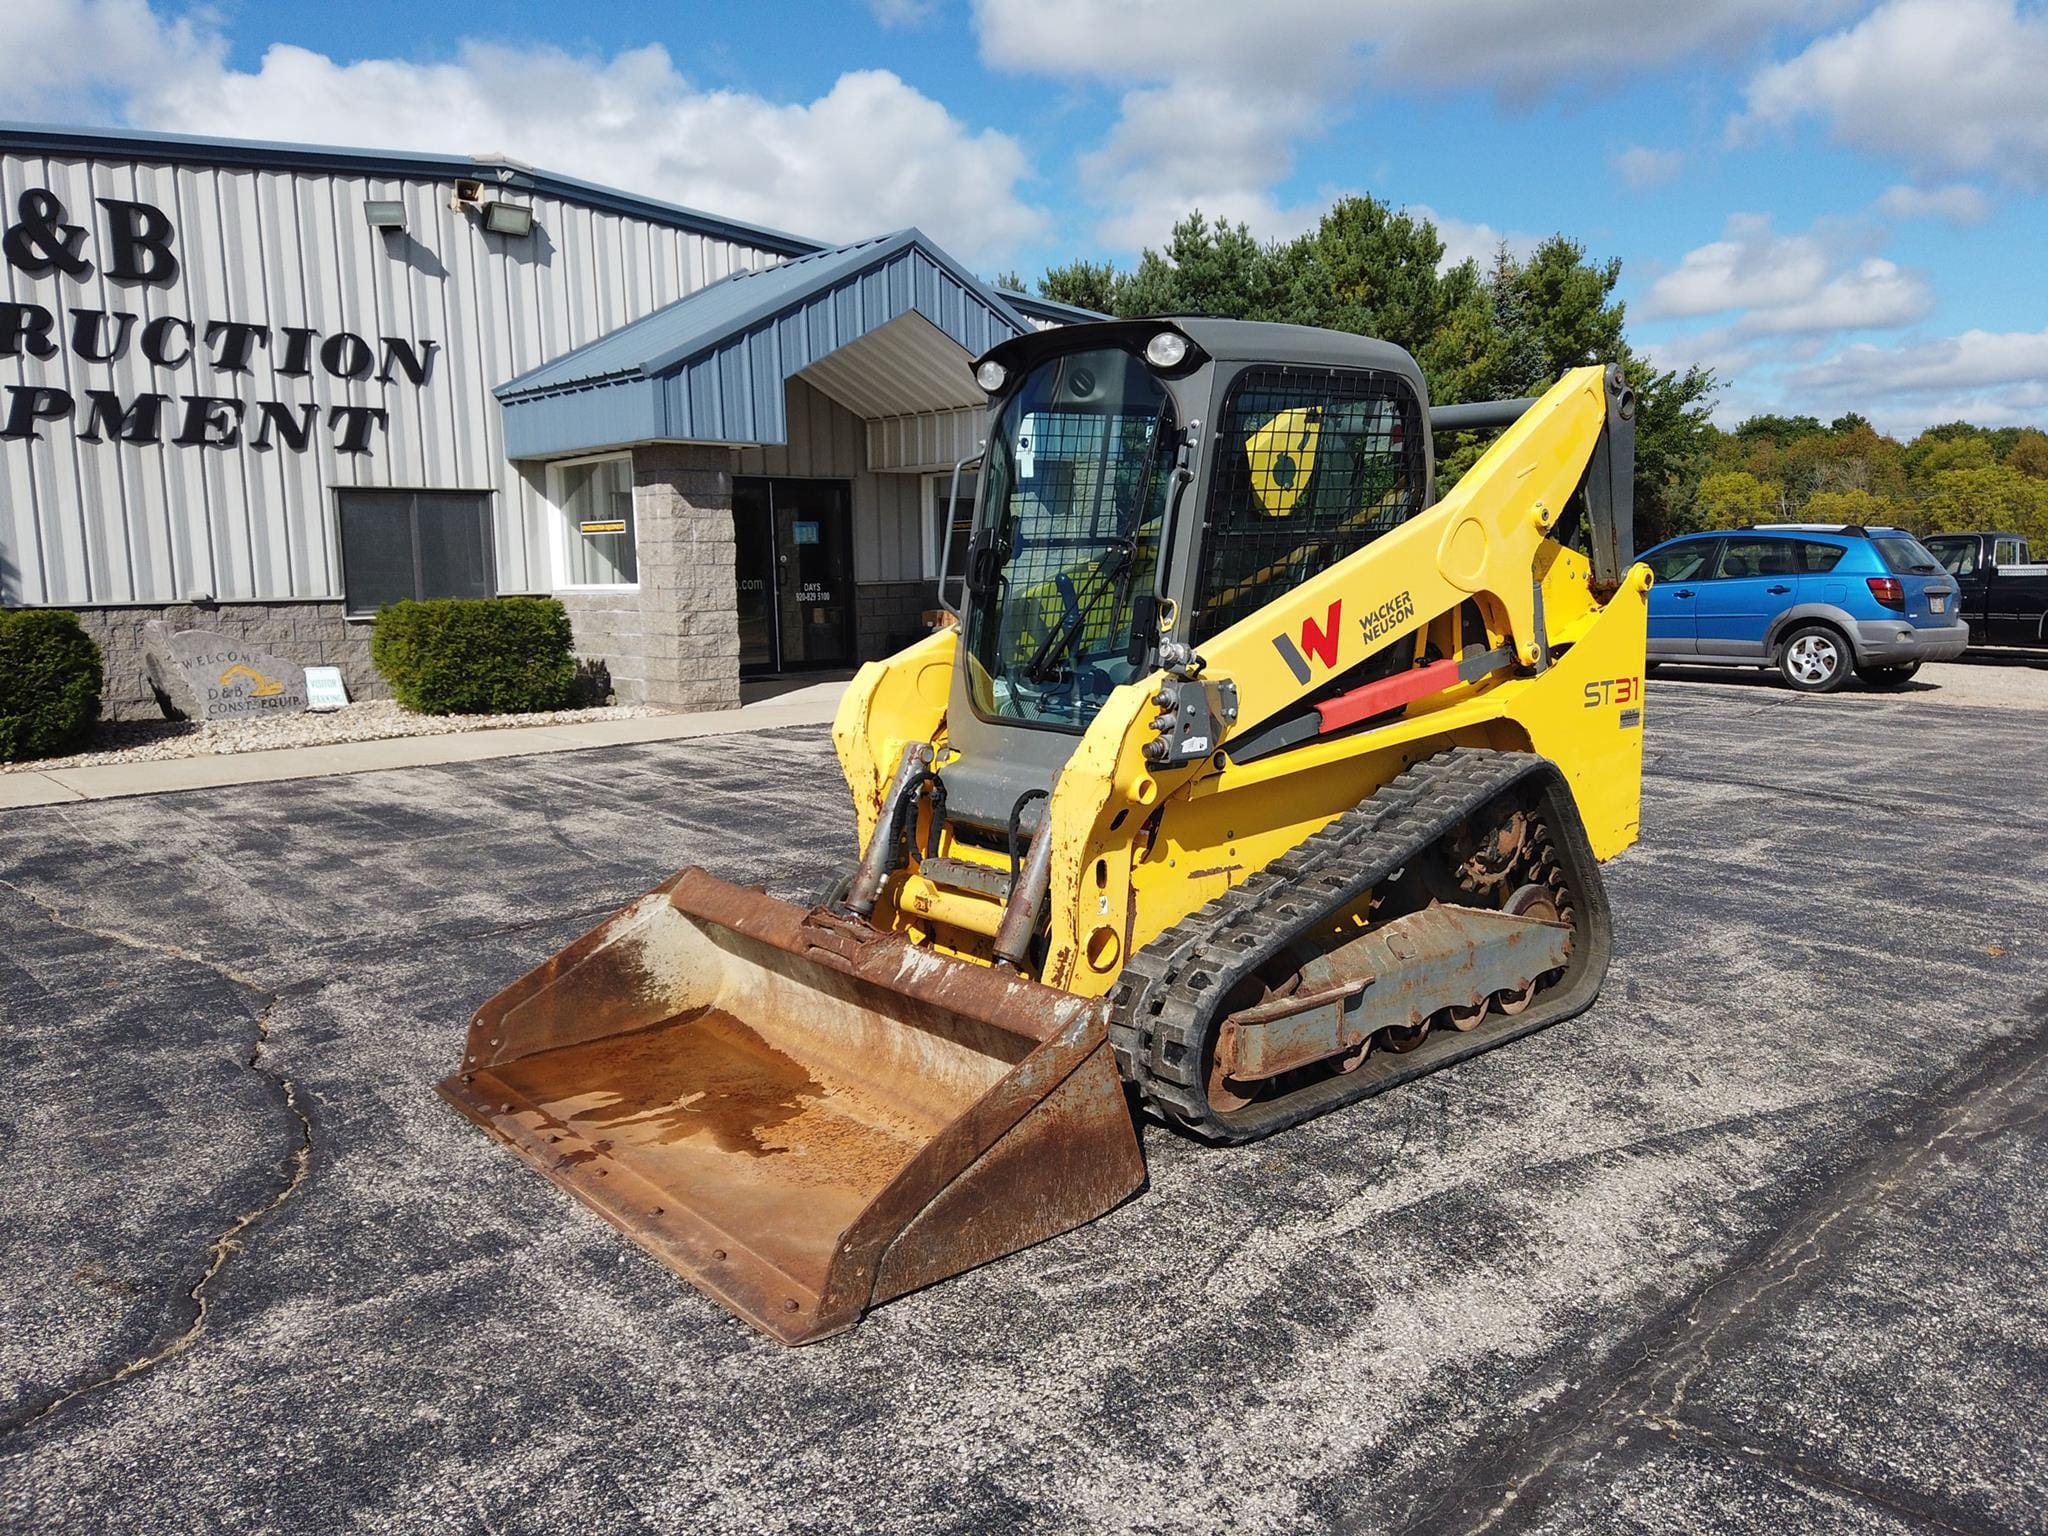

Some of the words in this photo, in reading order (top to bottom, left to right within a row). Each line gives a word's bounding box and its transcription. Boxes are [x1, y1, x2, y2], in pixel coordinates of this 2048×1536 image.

[0, 385, 386, 452] PMENT
[804, 583, 821, 592] DAYS
[1360, 591, 1412, 630] WACKER
[1362, 603, 1414, 645] NEUSON
[182, 651, 261, 670] WELCOME
[1584, 677, 1638, 707] ST31
